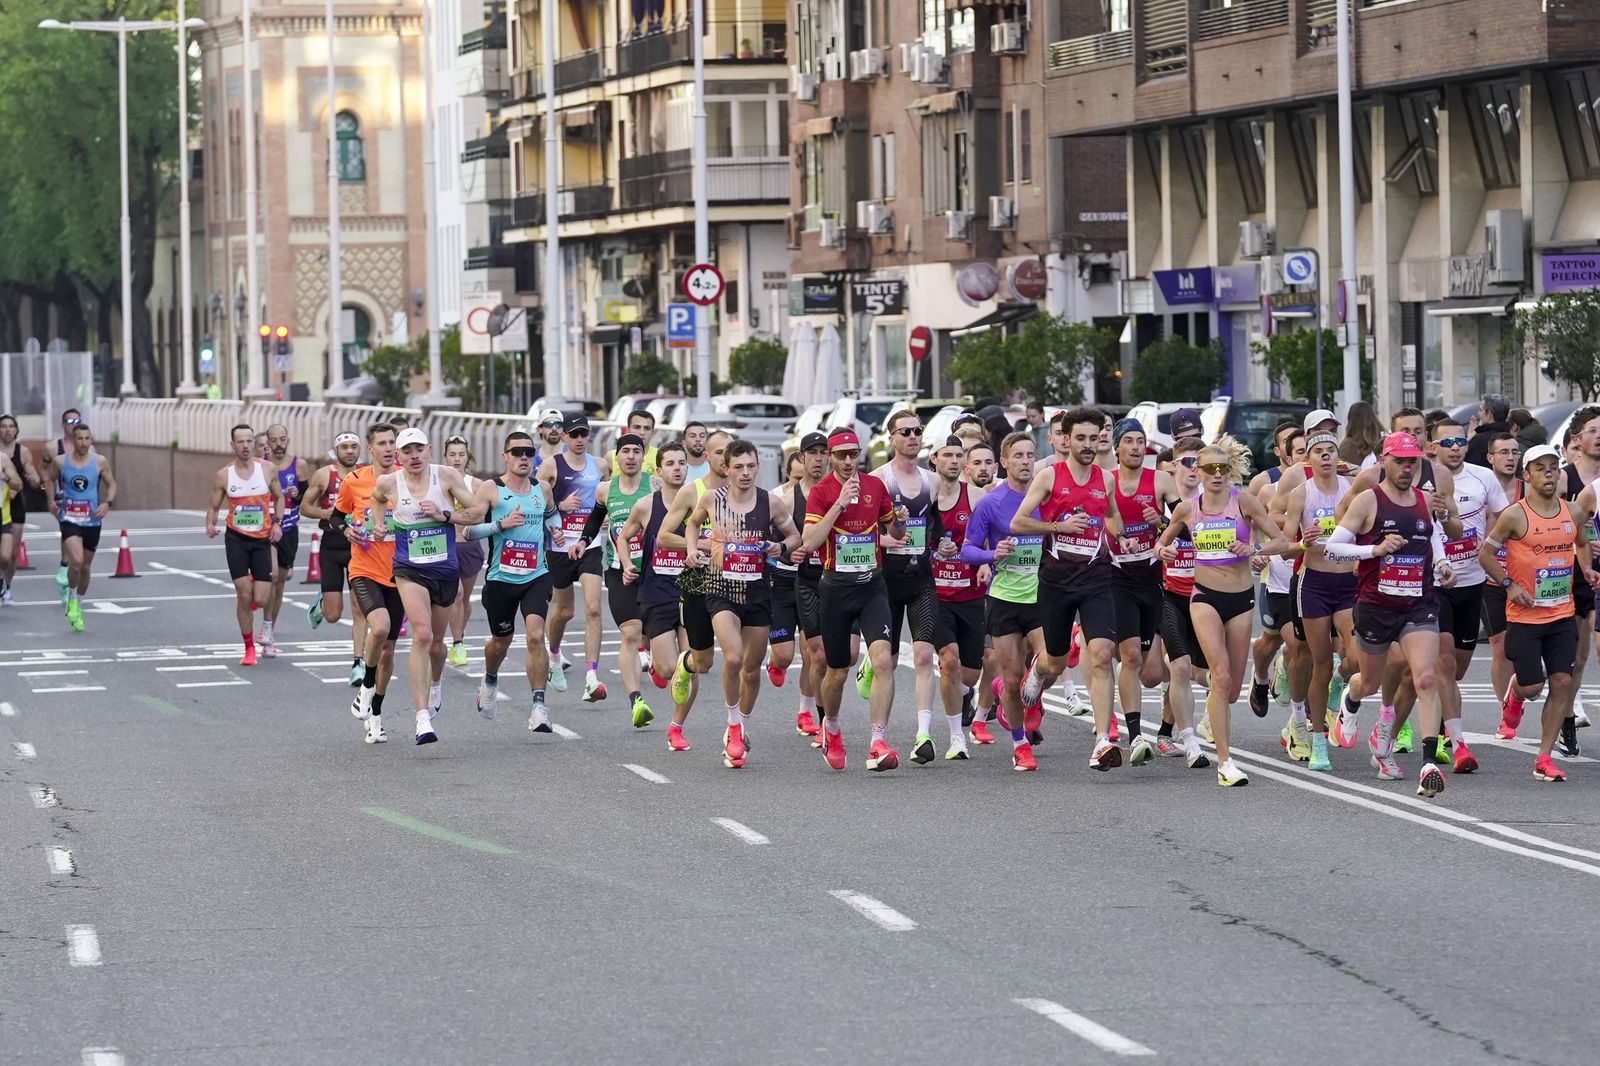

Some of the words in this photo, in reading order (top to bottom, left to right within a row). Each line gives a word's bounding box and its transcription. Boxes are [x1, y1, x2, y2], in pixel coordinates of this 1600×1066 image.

[1550, 260, 1595, 270] TATTOO
[853, 282, 899, 295] TINTE
[670, 307, 689, 332] P
[420, 528, 442, 536] ZURICH
[1125, 523, 1149, 533] ZURICH
[1057, 534, 1075, 544] CODE
[1076, 537, 1098, 548] BROWN
[420, 547, 437, 555] TOM
[509, 558, 528, 568] KATA
[843, 554, 870, 563] VICTOR
[1018, 556, 1037, 565] ERIK
[1396, 556, 1421, 564] ZURICH
[729, 562, 756, 572] VICTOR
[939, 570, 962, 579] FOLEY
[1378, 578, 1398, 587] JAIME
[1540, 586, 1568, 598] CARLOS
